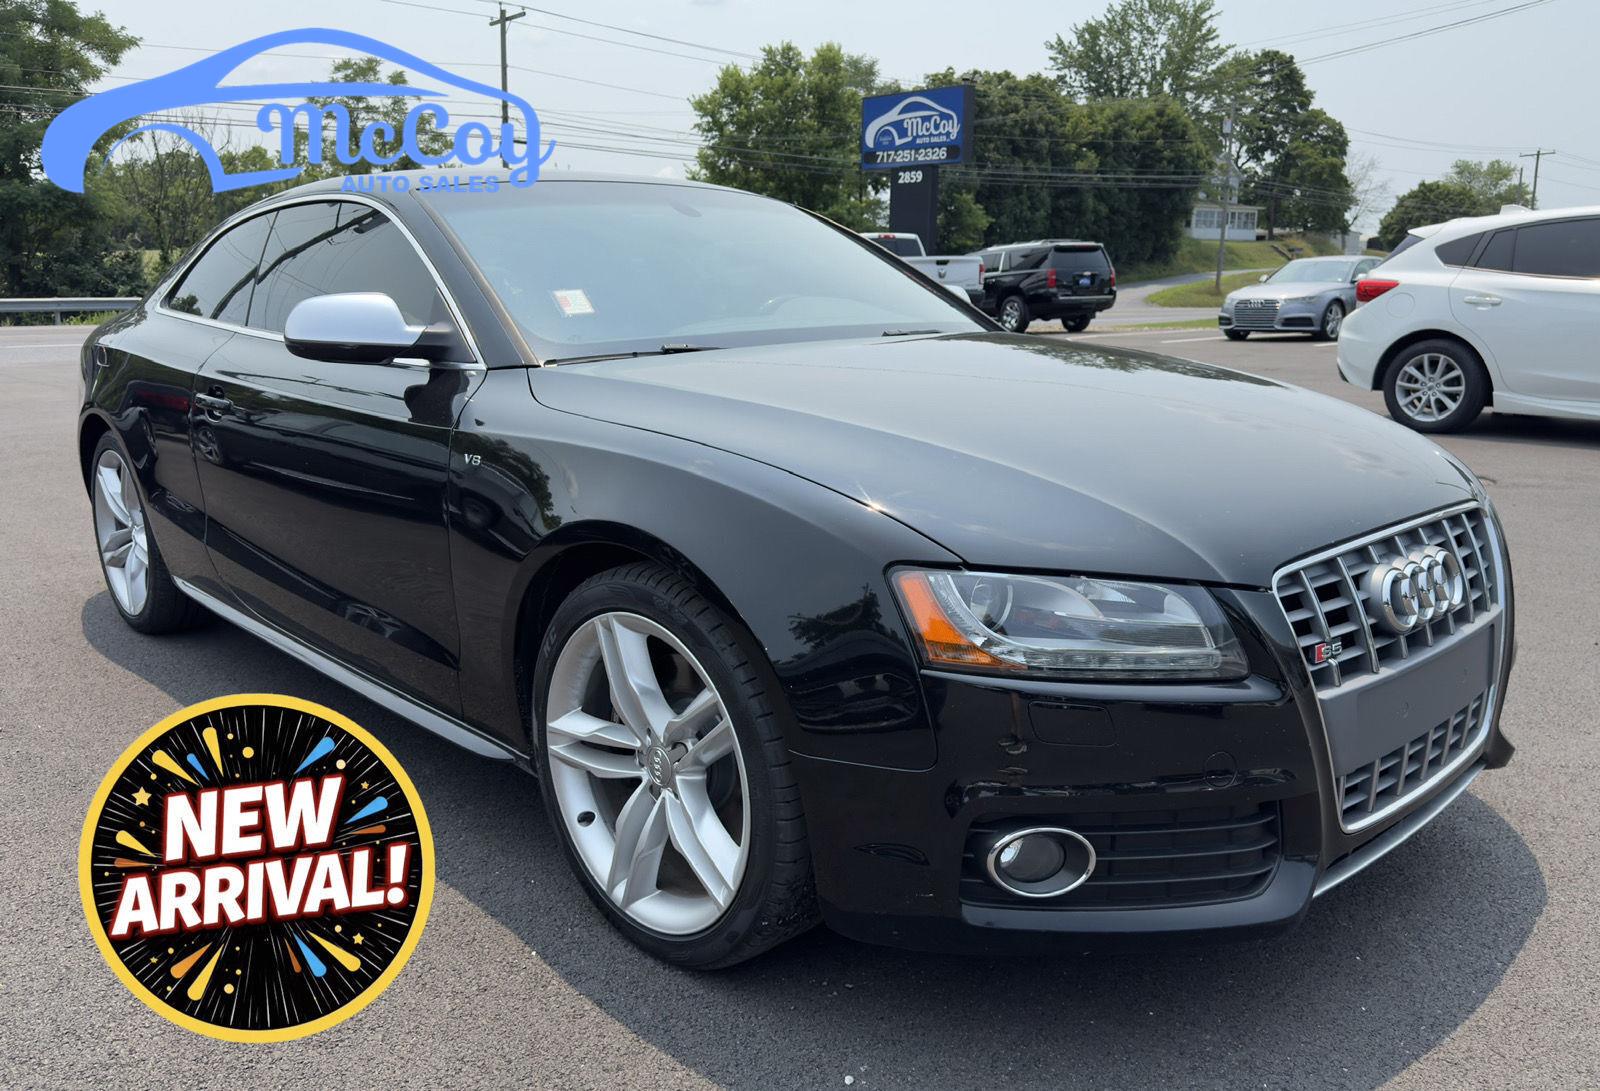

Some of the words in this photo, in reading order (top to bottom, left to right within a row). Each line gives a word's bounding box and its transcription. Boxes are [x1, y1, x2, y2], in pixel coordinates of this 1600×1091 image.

[903, 115, 961, 140] McCoy
[876, 147, 947, 163] 717-251-2326
[898, 170, 922, 183] 2859
[464, 453, 482, 466] V8
[1320, 641, 1342, 659] S5
